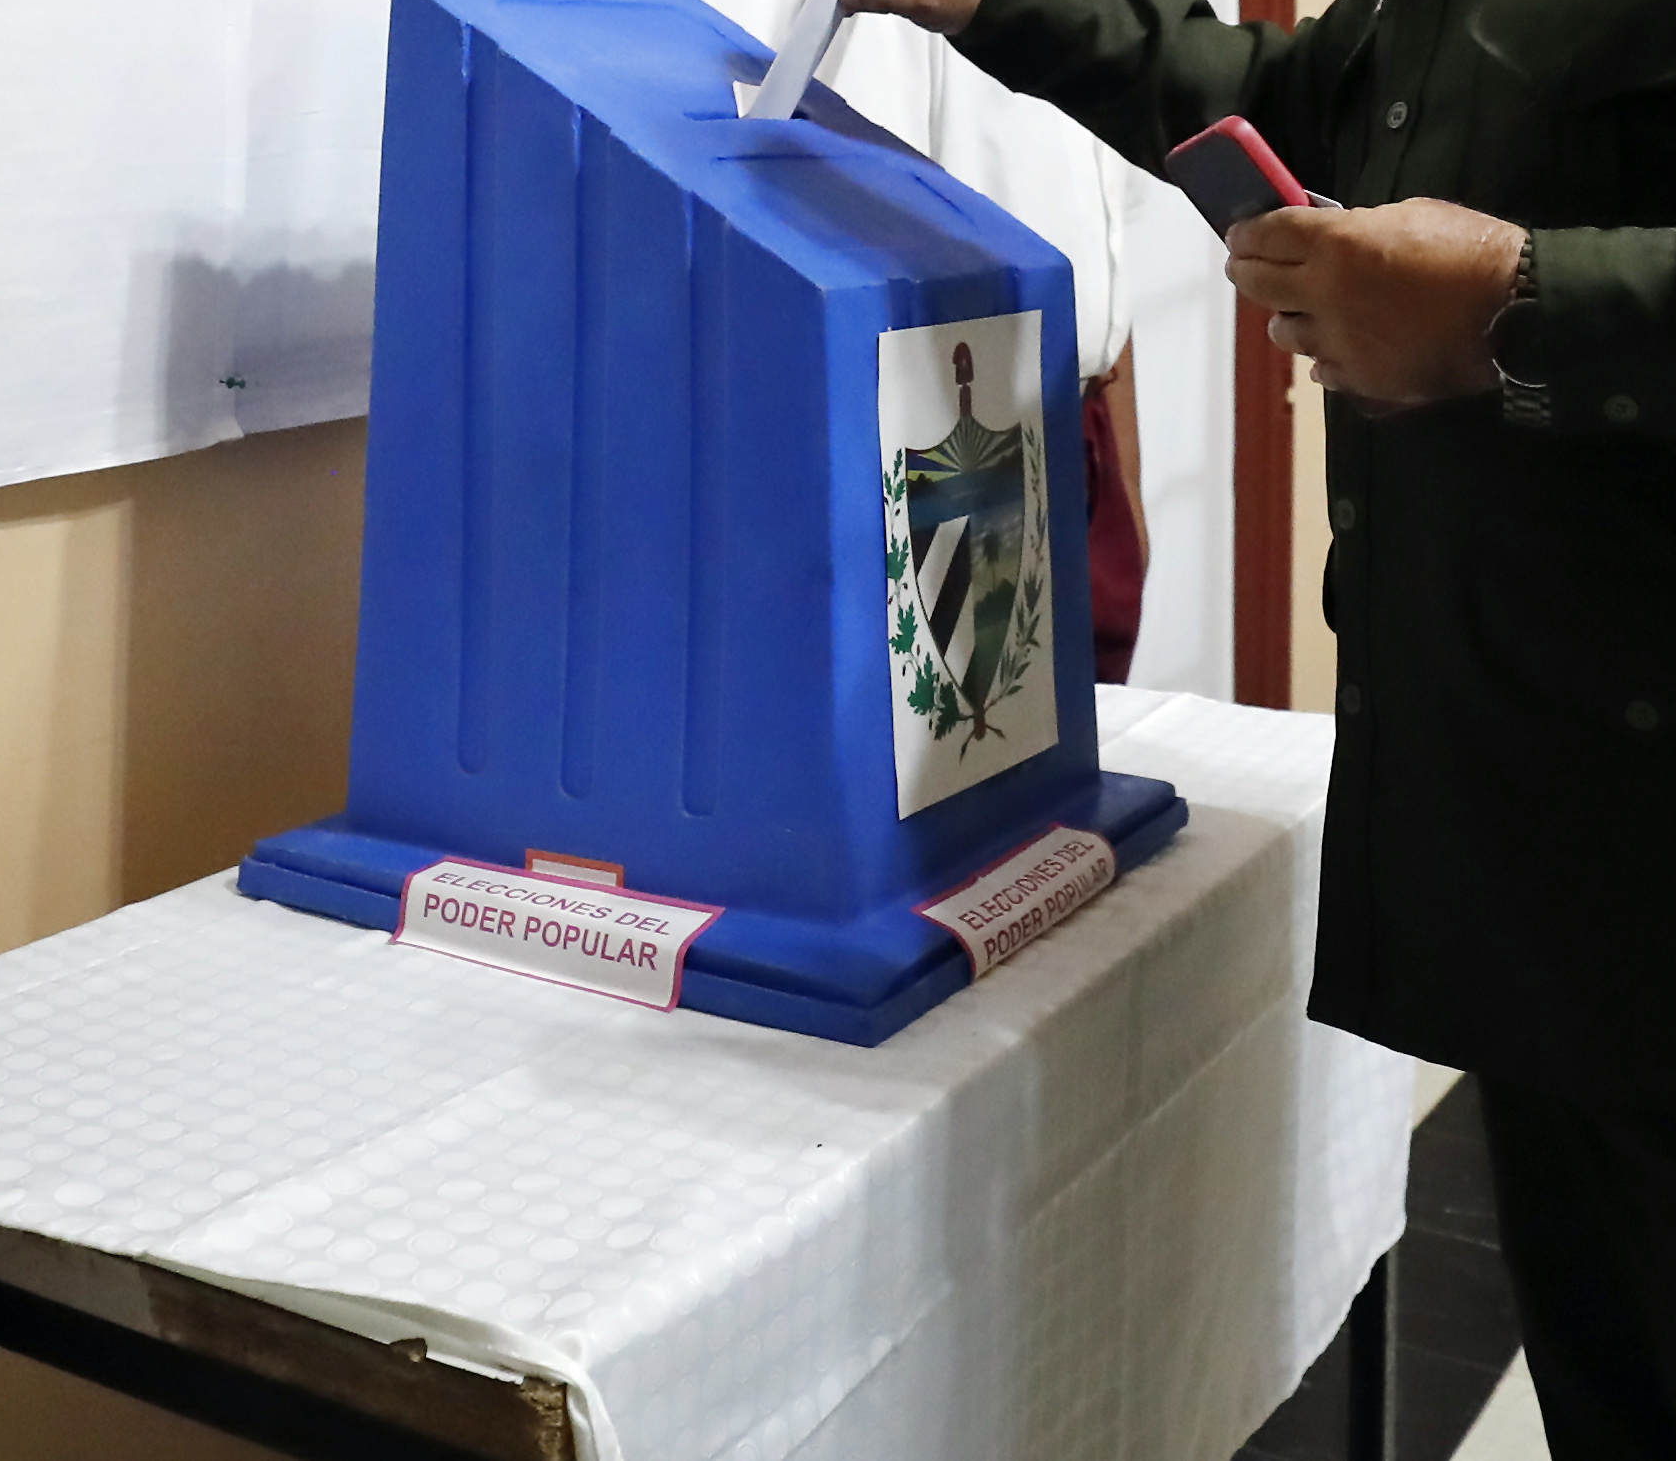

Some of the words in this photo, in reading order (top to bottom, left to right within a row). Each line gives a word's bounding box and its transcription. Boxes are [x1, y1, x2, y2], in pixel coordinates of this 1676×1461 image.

[432, 871, 612, 919] ELECCIONES
[615, 911, 670, 936] DEL
[958, 858, 1065, 931] ELECCIONES
[1054, 840, 1094, 863] DEL
[984, 907, 1043, 964] PODER
[1047, 857, 1108, 920] POPULAR
[423, 892, 514, 938] PODER
[523, 916, 658, 970] POPULAR
